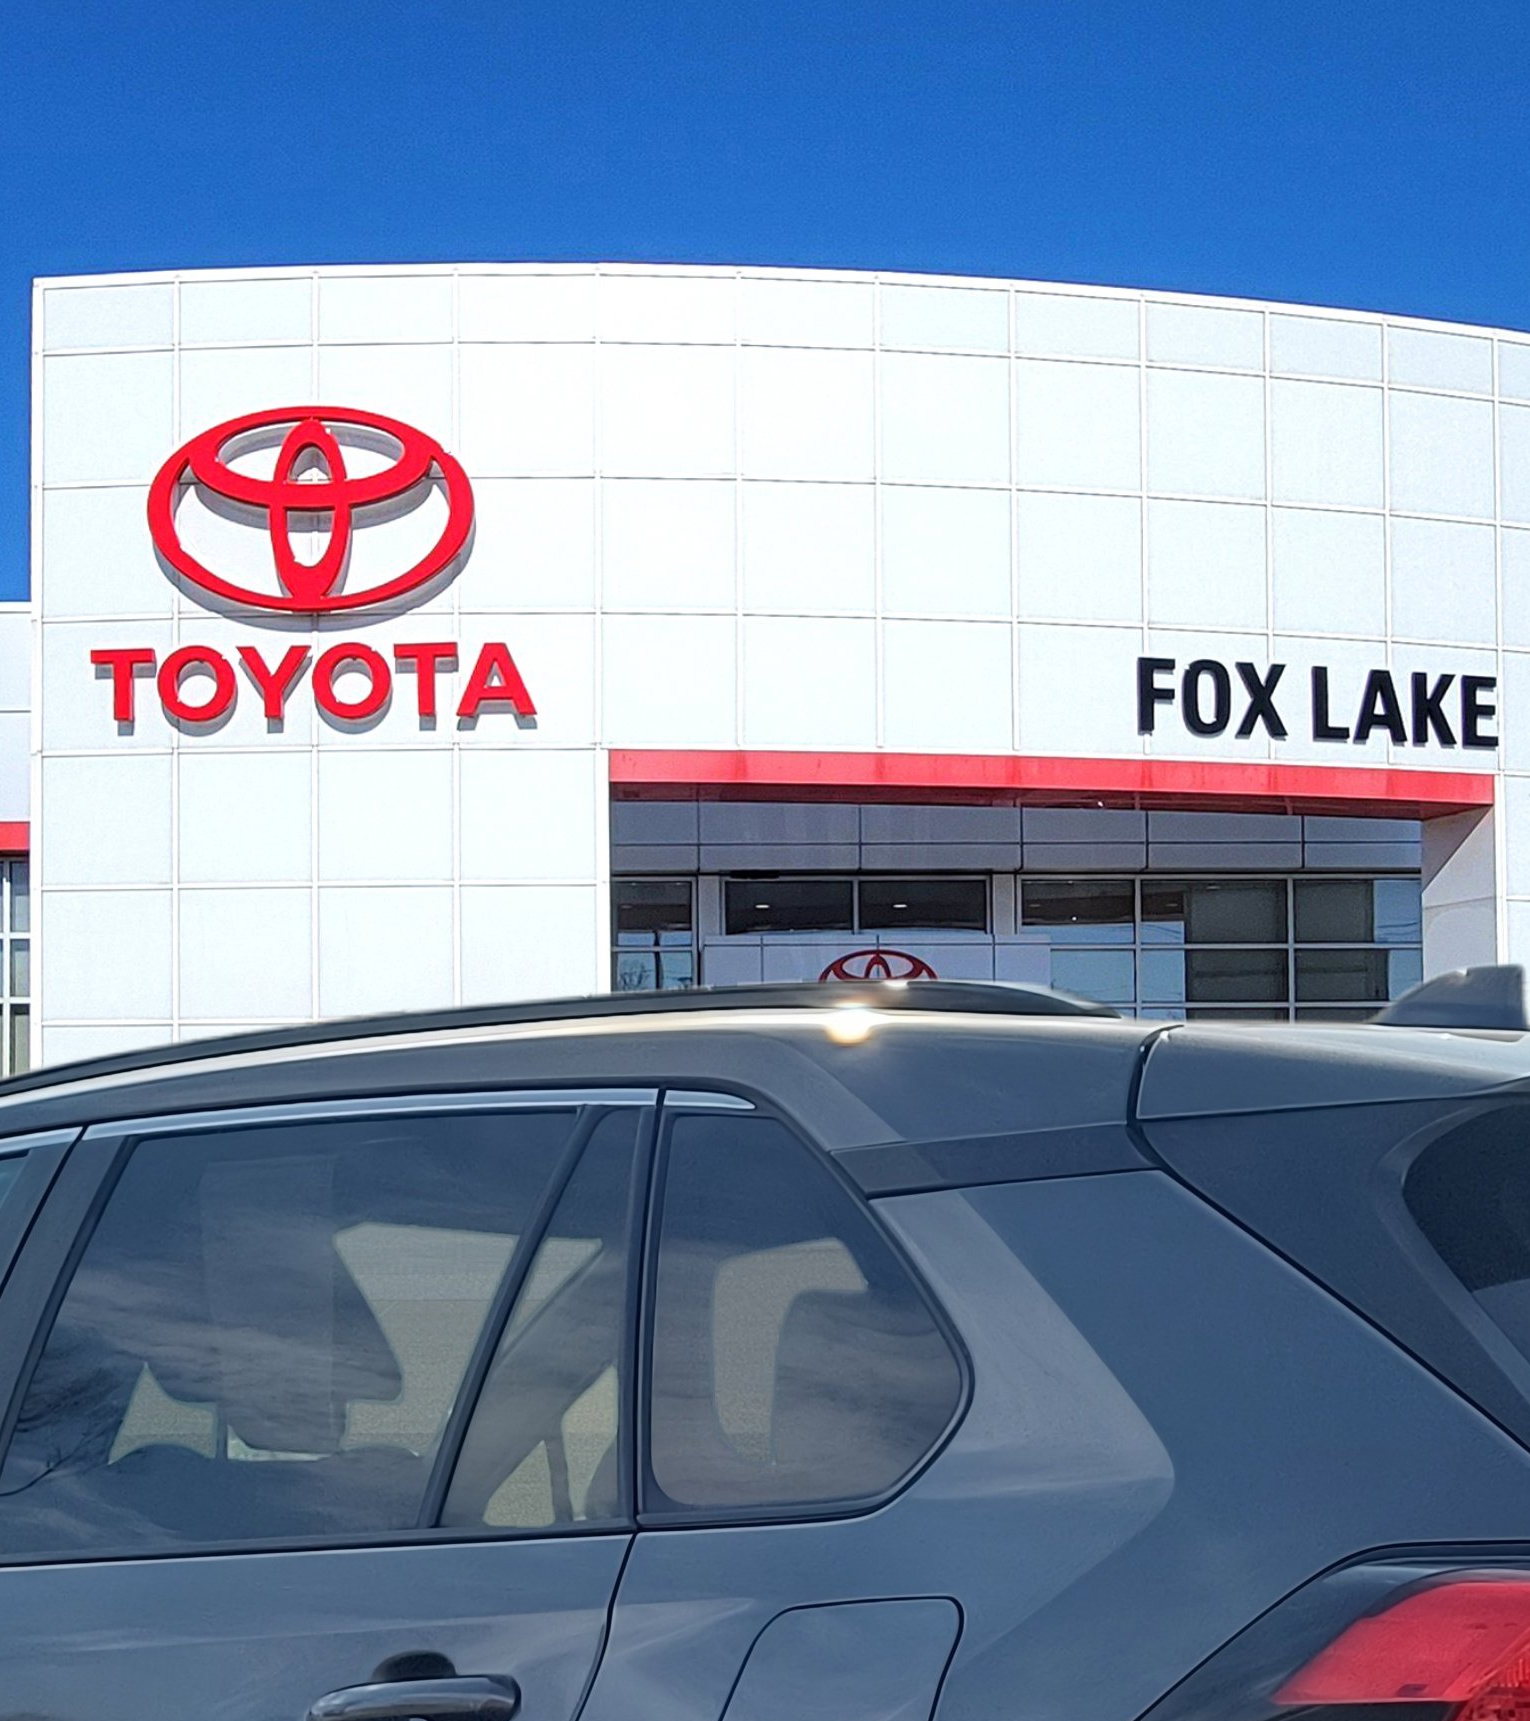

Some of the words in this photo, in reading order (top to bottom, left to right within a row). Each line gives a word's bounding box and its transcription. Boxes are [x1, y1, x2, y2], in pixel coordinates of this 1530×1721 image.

[90, 641, 538, 726] TOYOTA
[1136, 656, 1288, 738] FOX
[1310, 665, 1500, 748] LAKE
